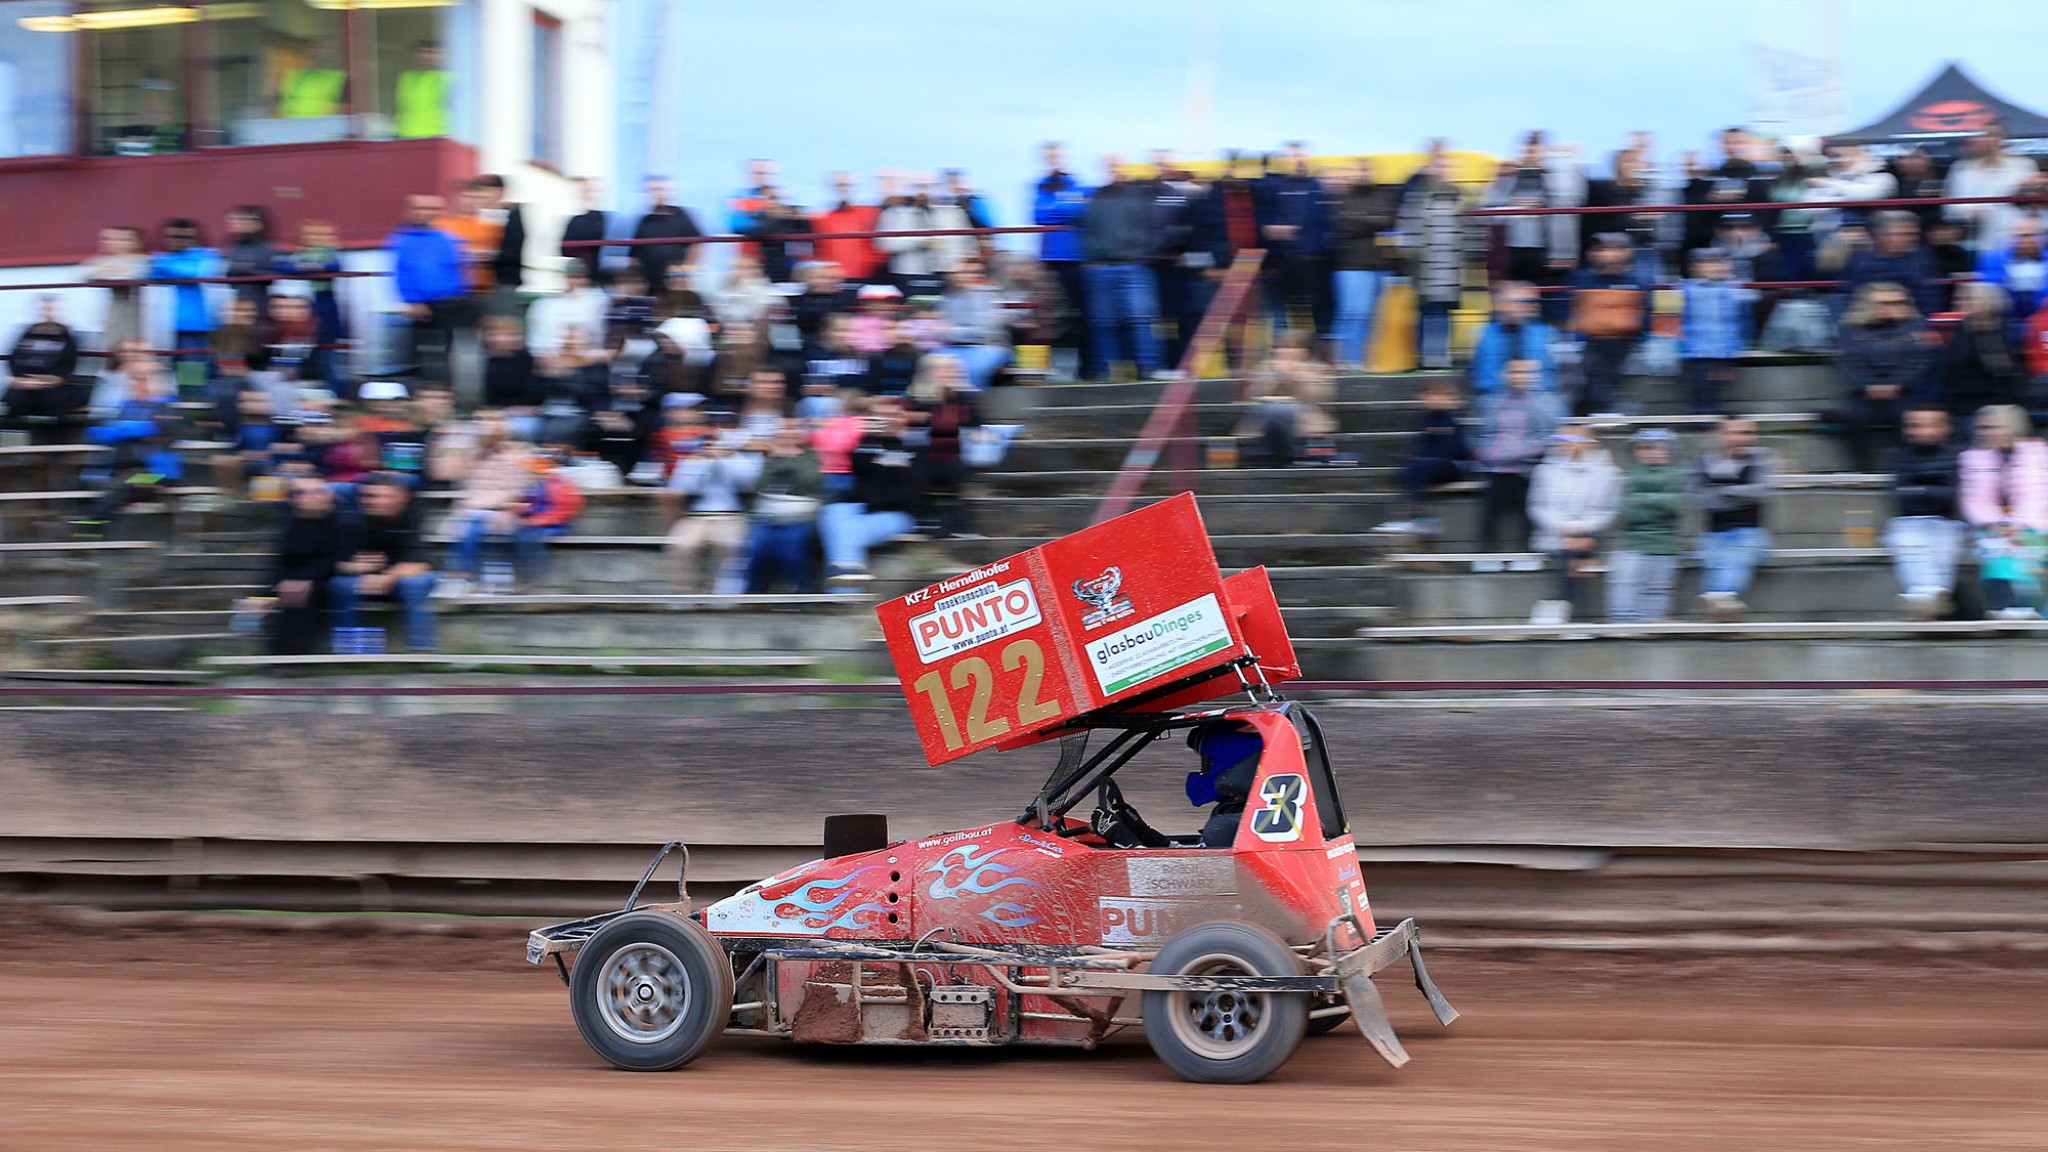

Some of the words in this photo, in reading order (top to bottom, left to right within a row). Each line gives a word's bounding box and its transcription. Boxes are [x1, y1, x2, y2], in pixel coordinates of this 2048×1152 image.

[904, 591, 932, 606] KFZ
[939, 561, 1011, 594] Herndlhofer
[918, 589, 1029, 648] PUNTO
[951, 624, 1009, 651] www.punto.at
[913, 638, 1062, 752] 122
[1250, 774, 1308, 843] 3
